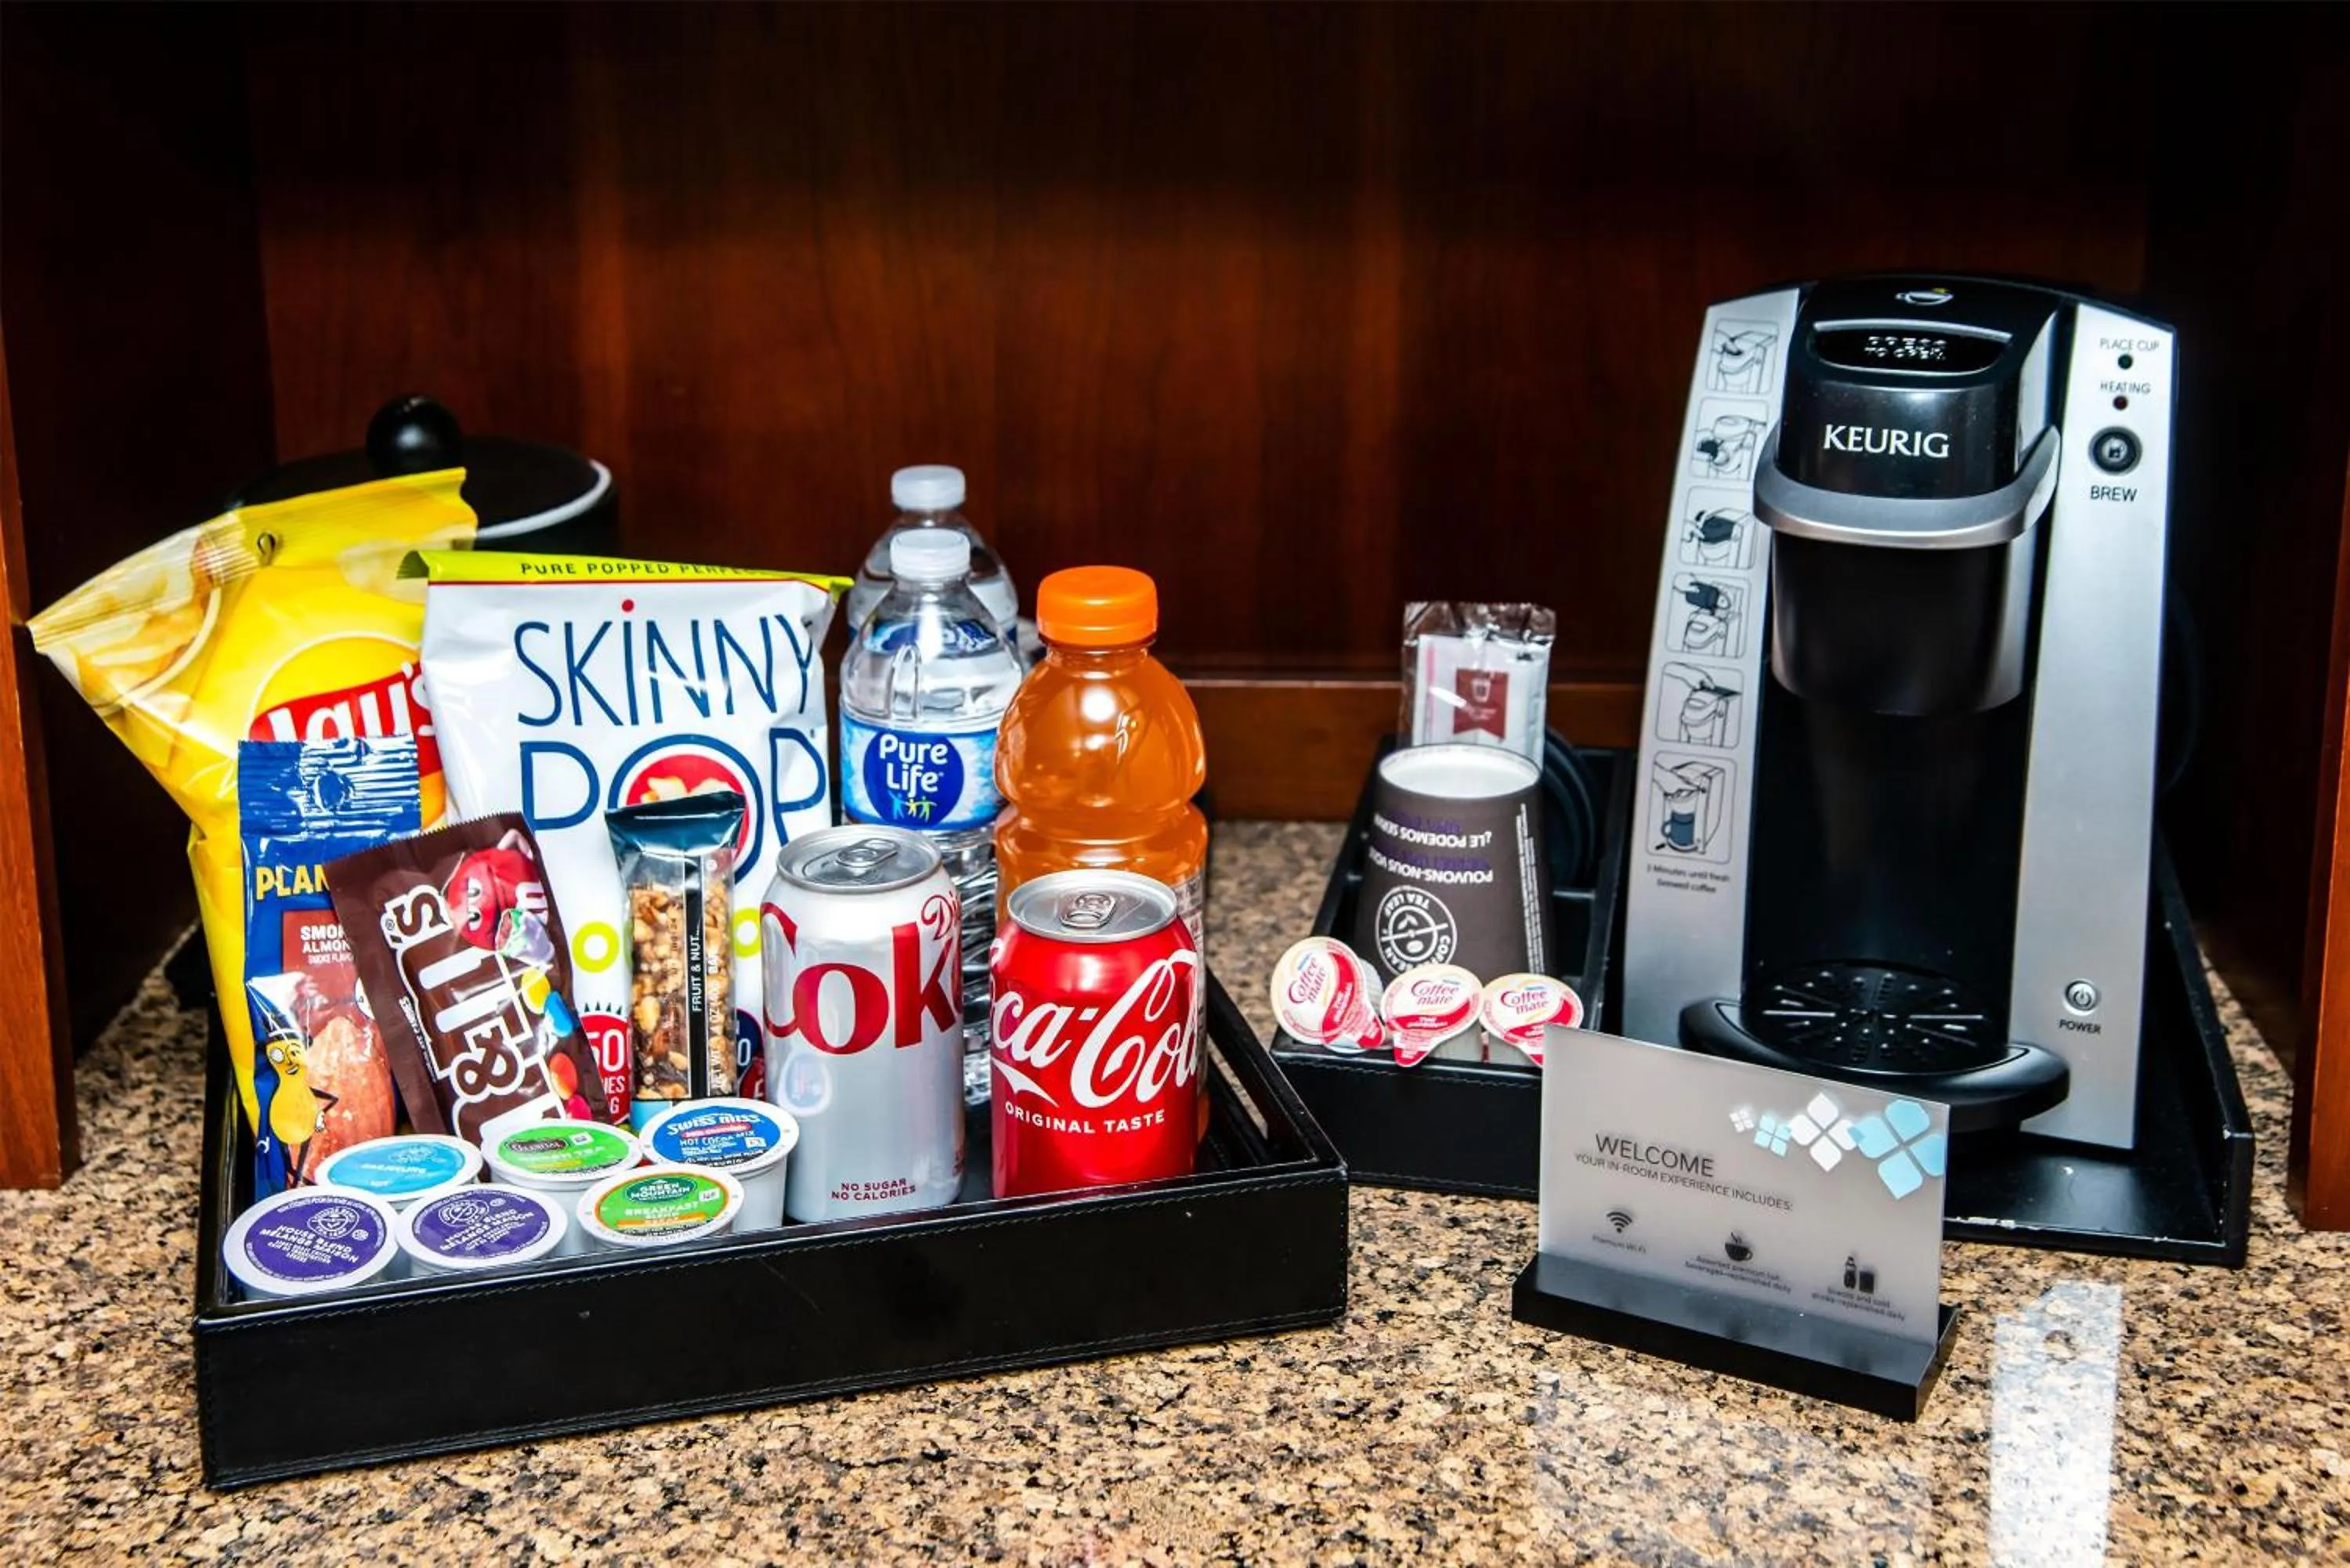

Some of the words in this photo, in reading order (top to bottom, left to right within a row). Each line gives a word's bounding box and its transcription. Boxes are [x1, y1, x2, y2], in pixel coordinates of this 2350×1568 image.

[2099, 338, 2134, 350] PLACE
[2137, 340, 2160, 352] CUP
[2100, 381, 2151, 394] HEATING
[1824, 424, 1950, 458] KEURIG
[2090, 486, 2138, 502] BREW
[521, 563, 577, 575] PURE
[588, 563, 670, 575] POPPED
[513, 598, 814, 727] SKINNY
[880, 734, 949, 765] Pure
[886, 763, 939, 798] Life
[1400, 827, 1466, 848] PODEMOS
[1388, 858, 1494, 883] POUVONS-NOUS
[255, 864, 330, 901] PLAN
[1383, 894, 1406, 917] LEAF
[1407, 893, 1430, 910] TEA
[302, 940, 351, 954] ALMON
[689, 935, 702, 962] NUT
[1432, 934, 1452, 964] COF
[692, 963, 702, 973] &
[760, 901, 963, 1055] Cok
[1289, 957, 1318, 1004] Coffee
[1306, 967, 1327, 1004] mate
[1411, 979, 1459, 996] Coffee
[691, 978, 703, 1012] FRUIT
[1417, 995, 1453, 1006] mate
[1500, 989, 1548, 1008] Coffee
[1516, 999, 1549, 1016] mate
[990, 938, 1198, 1108] ca-Col
[2059, 1019, 2101, 1035] POWER
[710, 1070, 722, 1089] NET
[1005, 1100, 1095, 1134] ORIGINAL
[1104, 1109, 1166, 1133] TASTE
[1596, 1133, 1715, 1177] WELCOME
[639, 1183, 680, 1192] GREEN
[841, 1183, 859, 1191] NO
[864, 1178, 906, 1191] SUGAR
[1574, 1152, 1605, 1167] YOUR
[1607, 1158, 1659, 1180] IN-ROOM
[1660, 1173, 1730, 1197] EXPERIENCE
[1731, 1188, 1794, 1211] INCLUDES:
[631, 1187, 690, 1198] MOUNTAIN
[831, 1191, 850, 1201] NO
[853, 1185, 916, 1201] CALORIES
[624, 1201, 699, 1216] BREAKFAST
[277, 1225, 316, 1240] HOUSE
[316, 1237, 352, 1252] BLEND
[313, 1245, 360, 1263] MAISON
